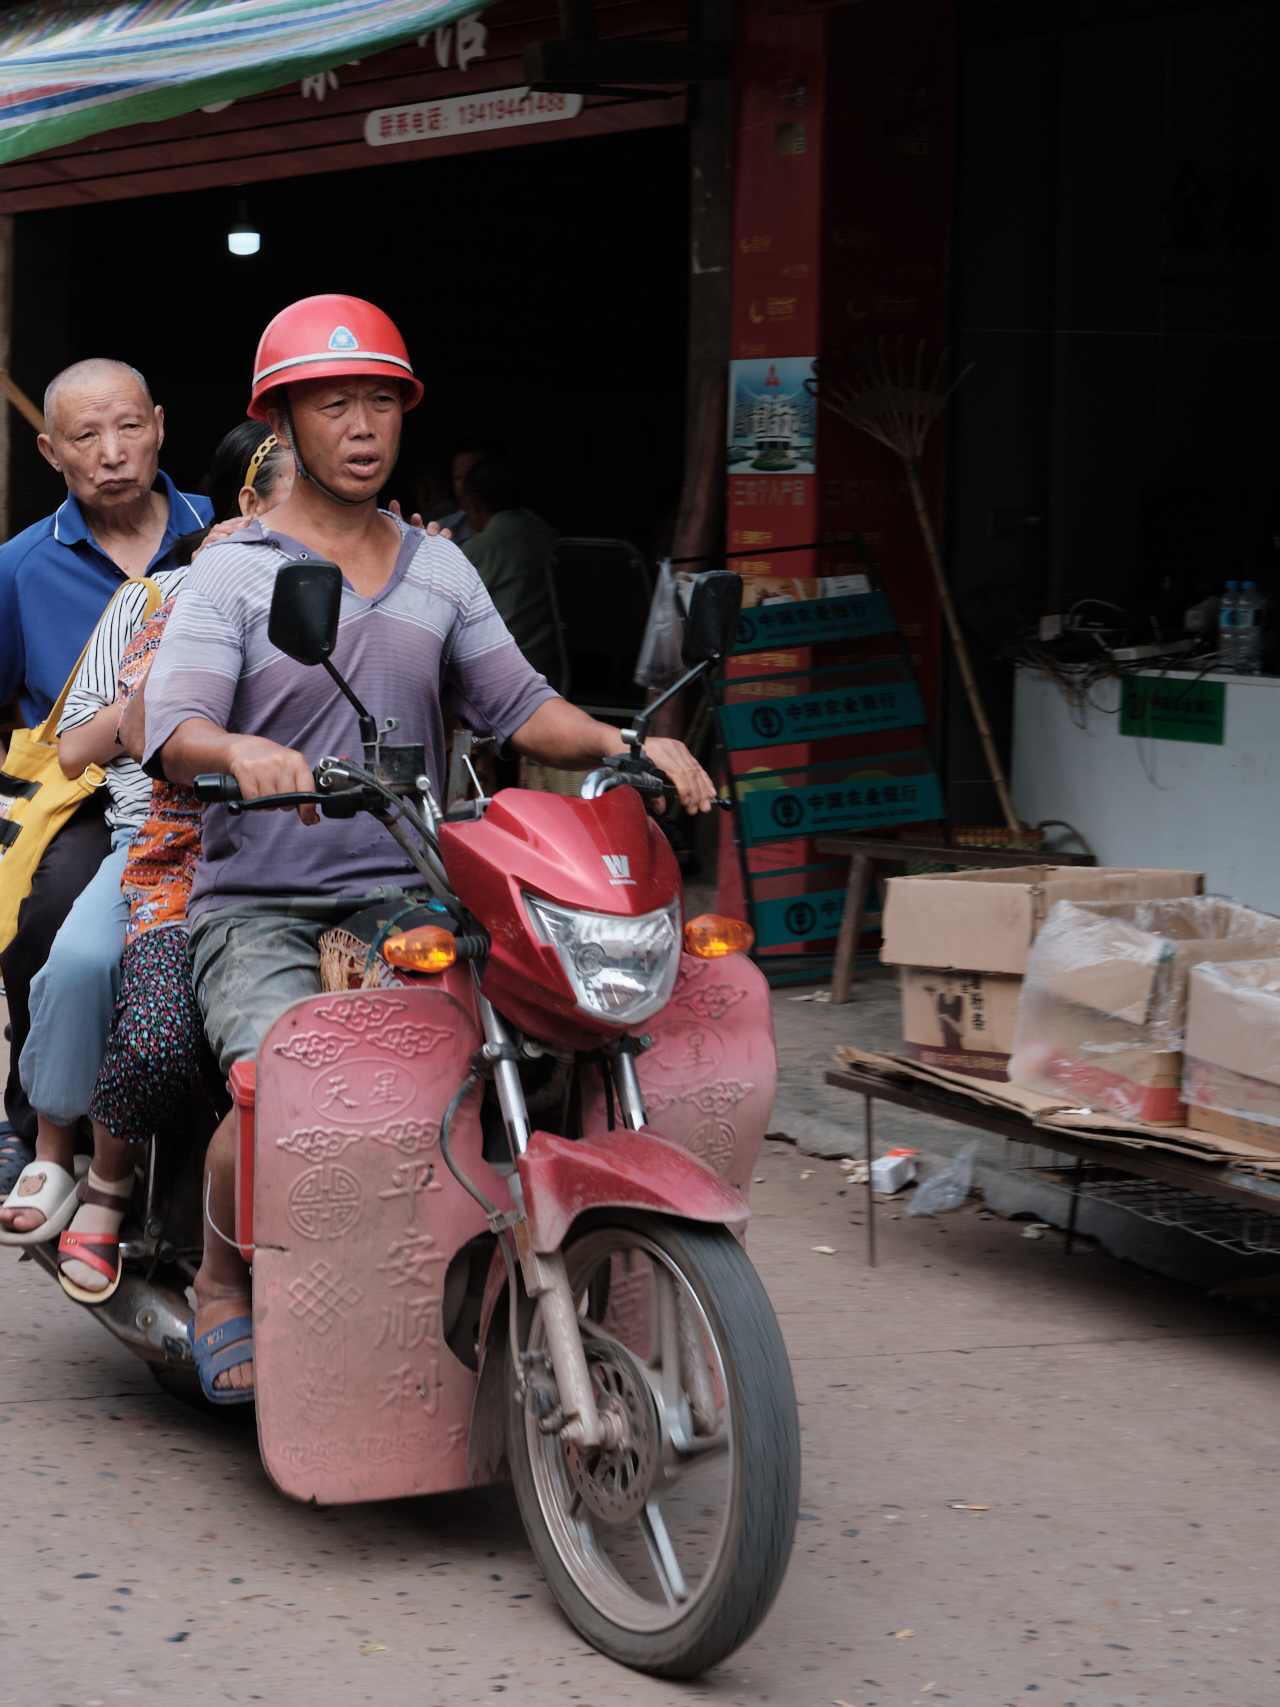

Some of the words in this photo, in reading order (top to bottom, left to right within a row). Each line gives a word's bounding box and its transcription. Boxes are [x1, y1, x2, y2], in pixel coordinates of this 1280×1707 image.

[785, 692, 896, 721] 中国农业银行
[807, 785, 918, 811] 中国农业银行
[375, 1158, 447, 1416] 平安顺利
